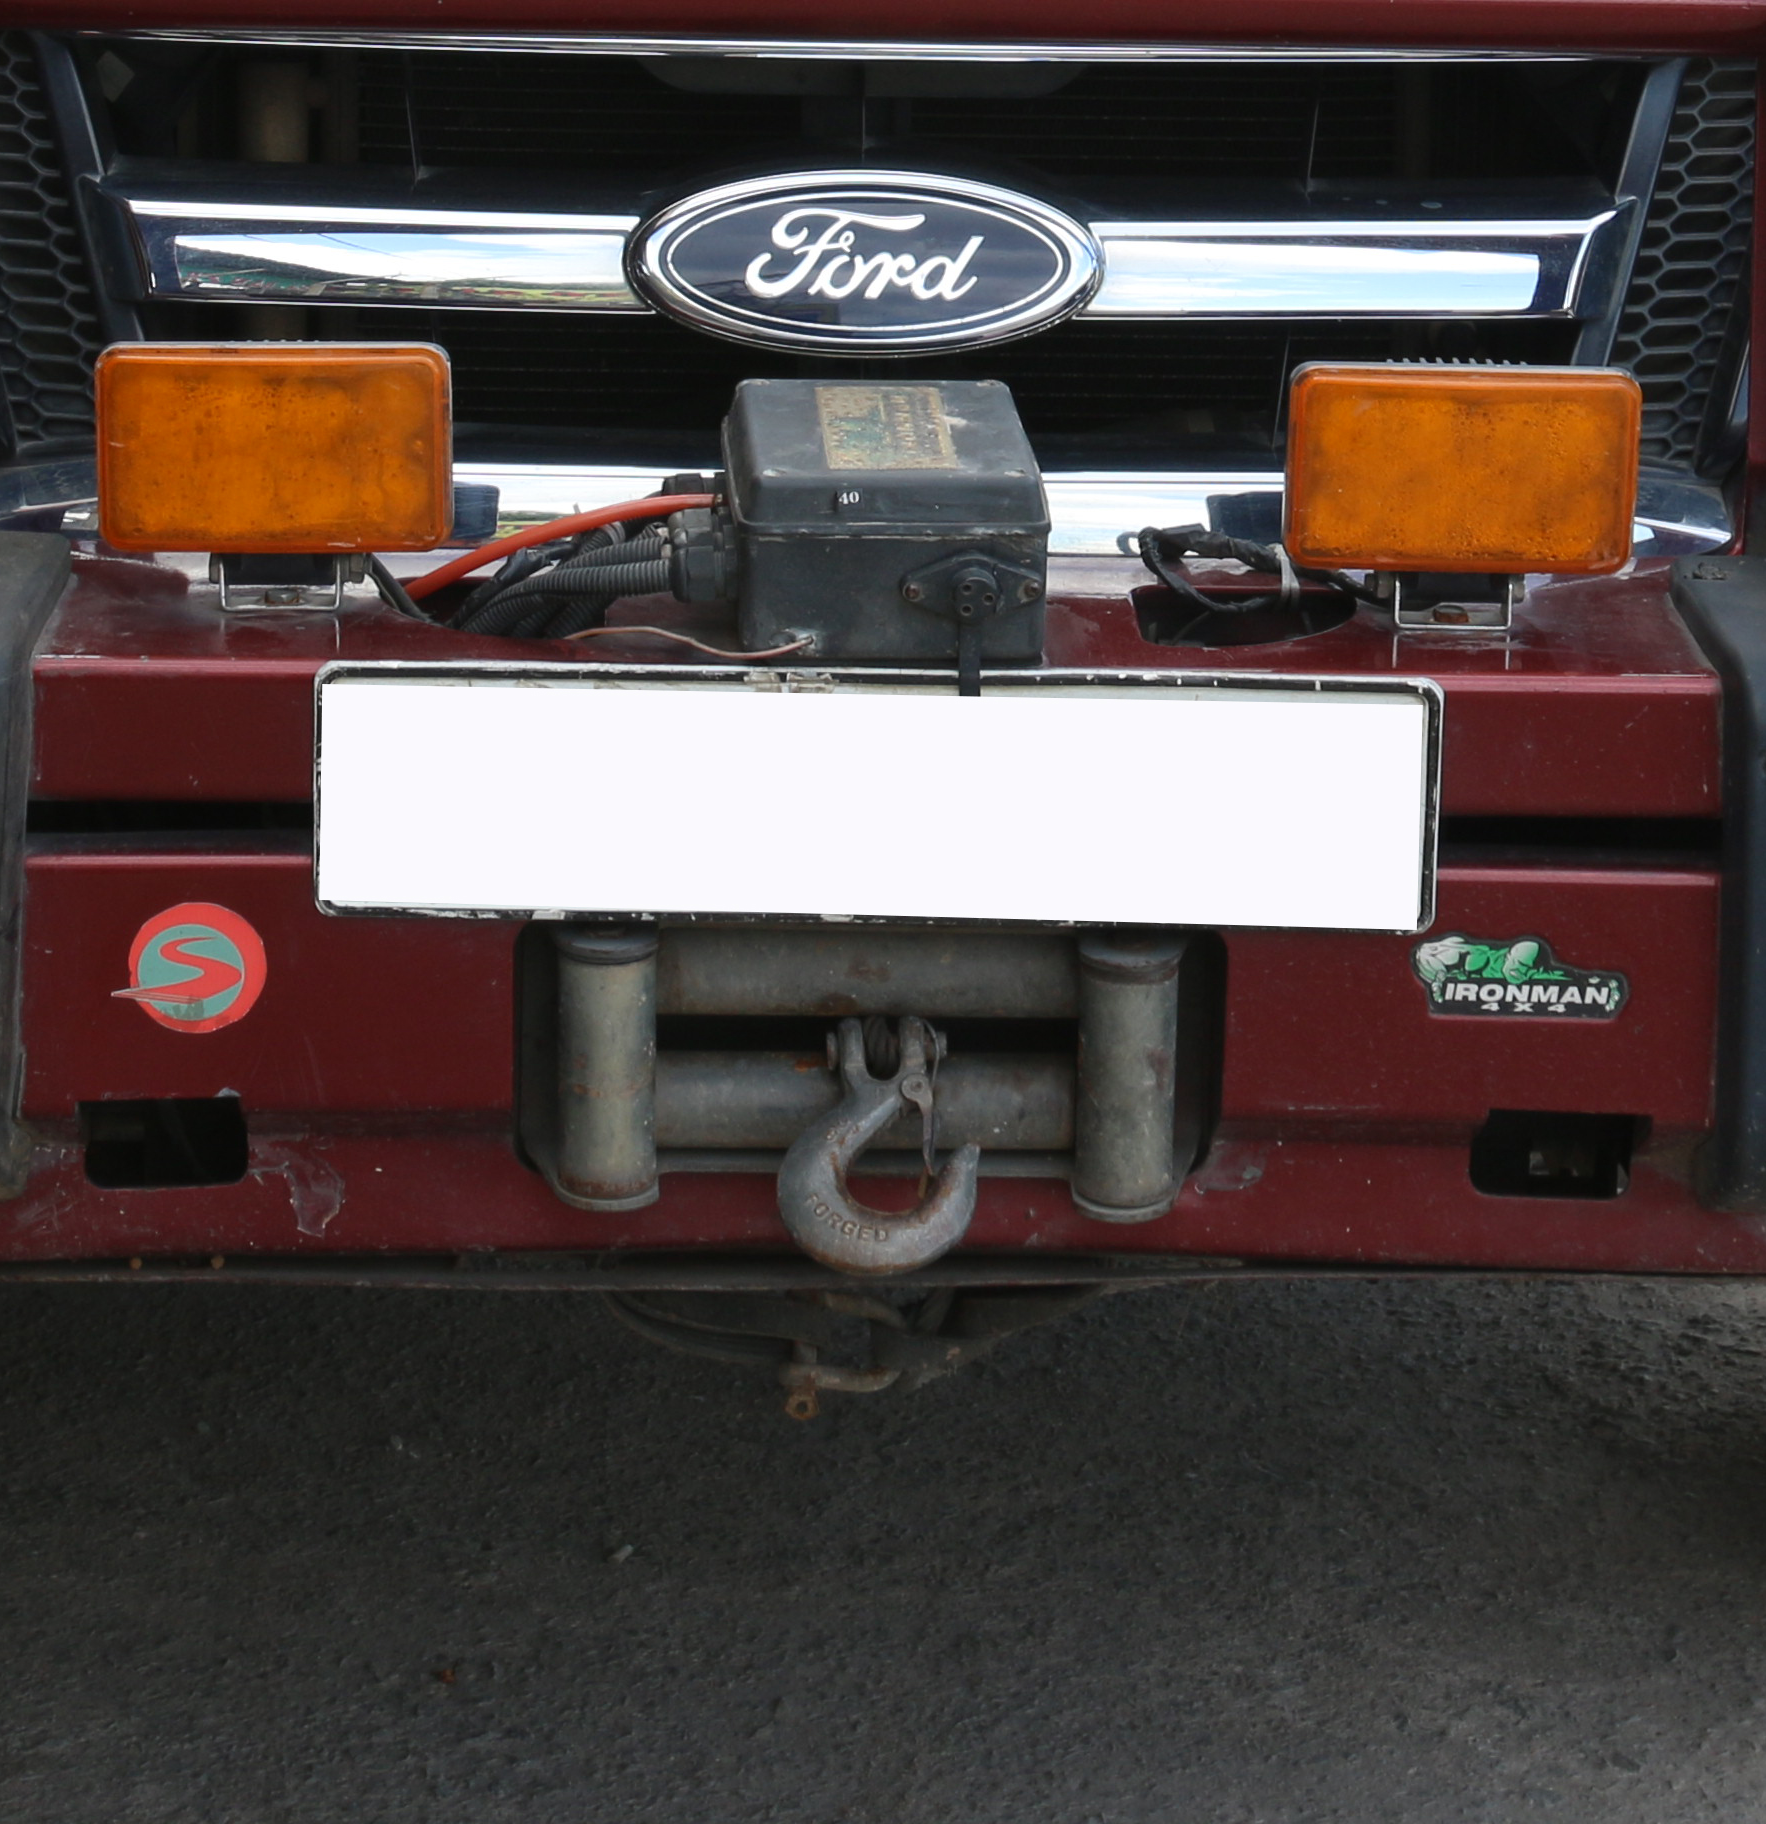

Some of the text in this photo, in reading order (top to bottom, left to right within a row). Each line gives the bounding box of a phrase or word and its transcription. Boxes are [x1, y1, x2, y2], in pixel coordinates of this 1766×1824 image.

[744, 207, 986, 302] Ford
[837, 490, 861, 506] 40
[1444, 982, 1610, 1005] IRONMAN
[804, 1192, 890, 1244] FORGED
